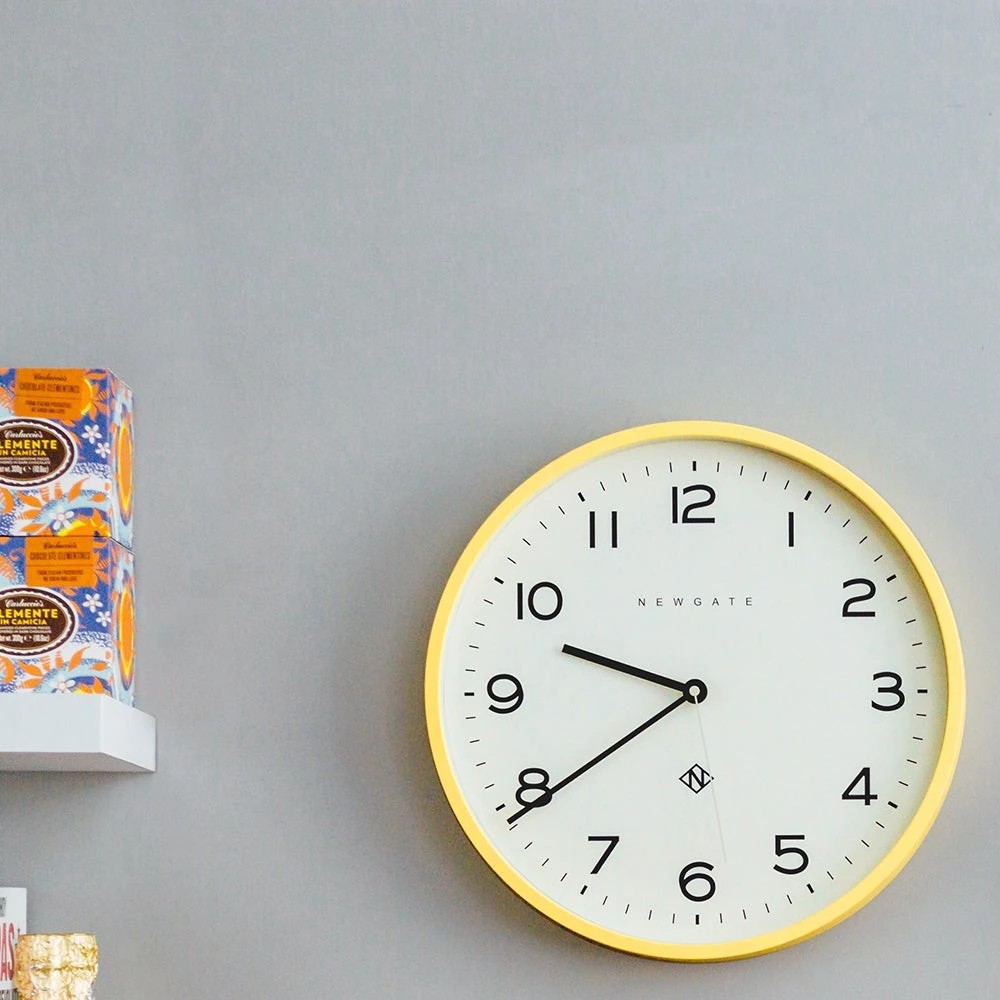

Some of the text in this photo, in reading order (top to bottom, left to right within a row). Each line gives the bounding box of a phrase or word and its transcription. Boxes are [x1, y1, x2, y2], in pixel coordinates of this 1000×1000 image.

[671, 484, 716, 524] 12
[589, 511, 618, 548] 11
[788, 511, 795, 547] 1
[517, 581, 563, 621] 10
[638, 597, 754, 607] NEWGATE
[842, 577, 876, 617] 2
[486, 673, 525, 715] 9
[870, 671, 905, 712] 3
[515, 768, 553, 808] 8
[841, 767, 878, 806] 4
[587, 835, 620, 875] 7
[773, 834, 809, 875] 5
[678, 861, 716, 902] 6
